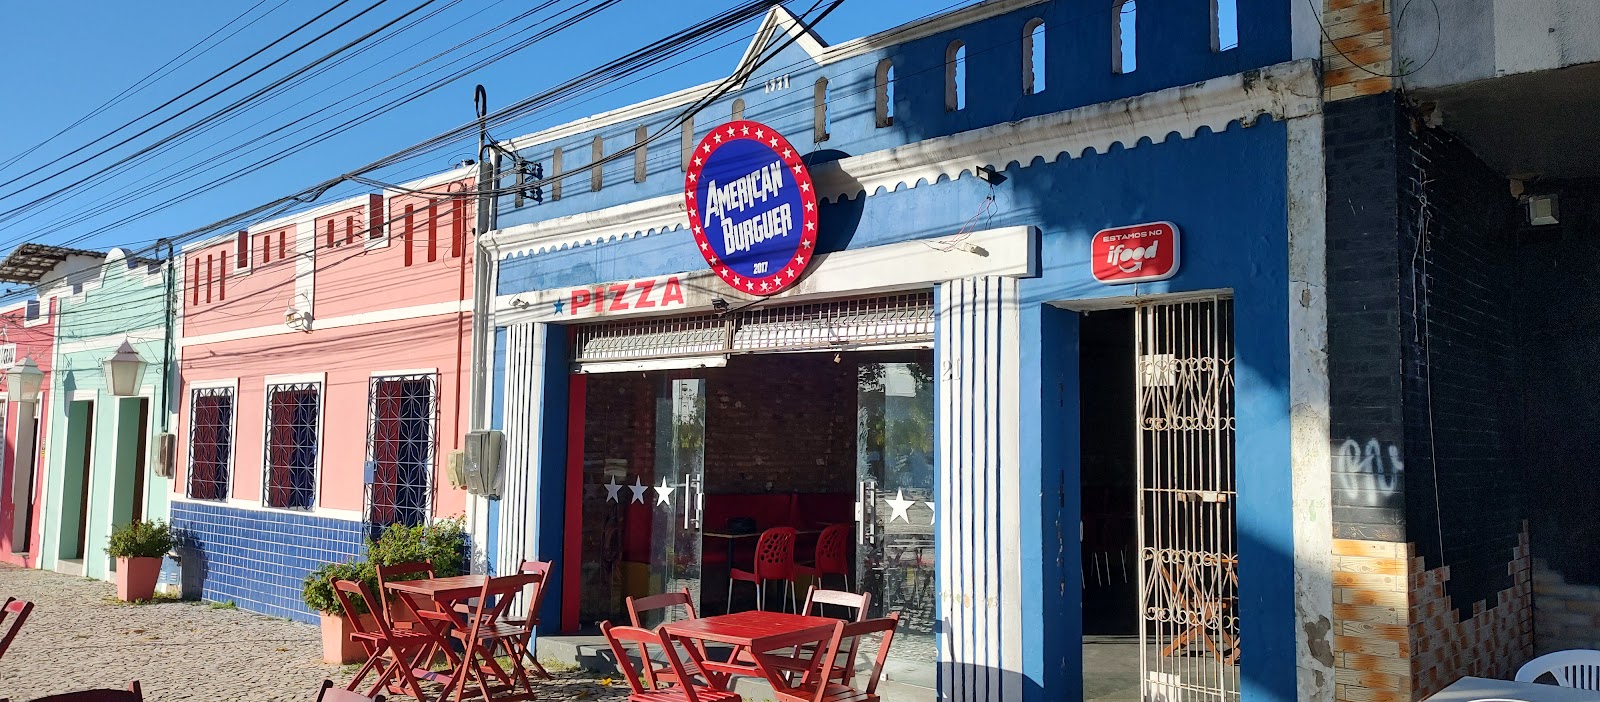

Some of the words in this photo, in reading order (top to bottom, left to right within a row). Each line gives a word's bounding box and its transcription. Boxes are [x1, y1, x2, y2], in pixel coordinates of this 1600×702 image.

[721, 203, 793, 256] BURGUER
[1102, 231, 1148, 243] ESTAMOS
[1148, 229, 1163, 237] NO
[1106, 240, 1159, 266] ifood
[753, 261, 769, 275] 2017
[570, 276, 684, 315] PIZZA
